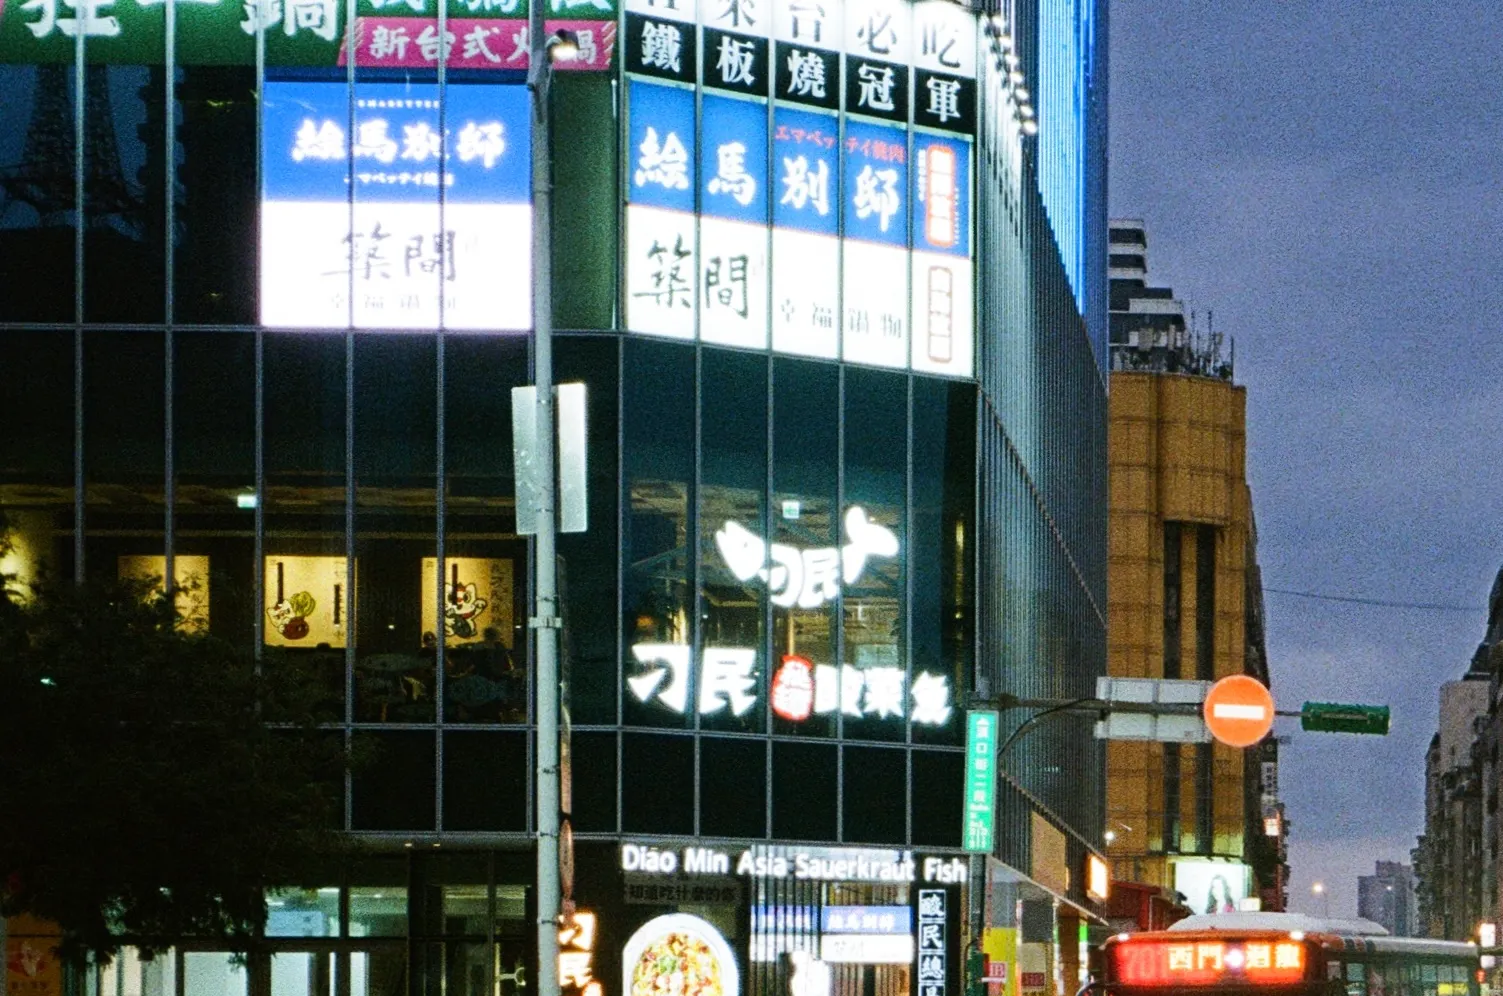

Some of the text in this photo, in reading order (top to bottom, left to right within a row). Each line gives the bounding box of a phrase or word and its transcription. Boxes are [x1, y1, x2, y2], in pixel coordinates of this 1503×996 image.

[643, 0, 961, 68] 來台必吃
[640, 20, 961, 123] 鐵板燒冠軍
[320, 221, 456, 282] 築間
[632, 231, 750, 320] 築間
[627, 643, 758, 716] 刁民
[683, 847, 730, 875] Min
[736, 850, 788, 876] Asia
[794, 849, 916, 880] Sauerkraut
[924, 856, 968, 883] Fish
[1169, 944, 1223, 970] 西門
